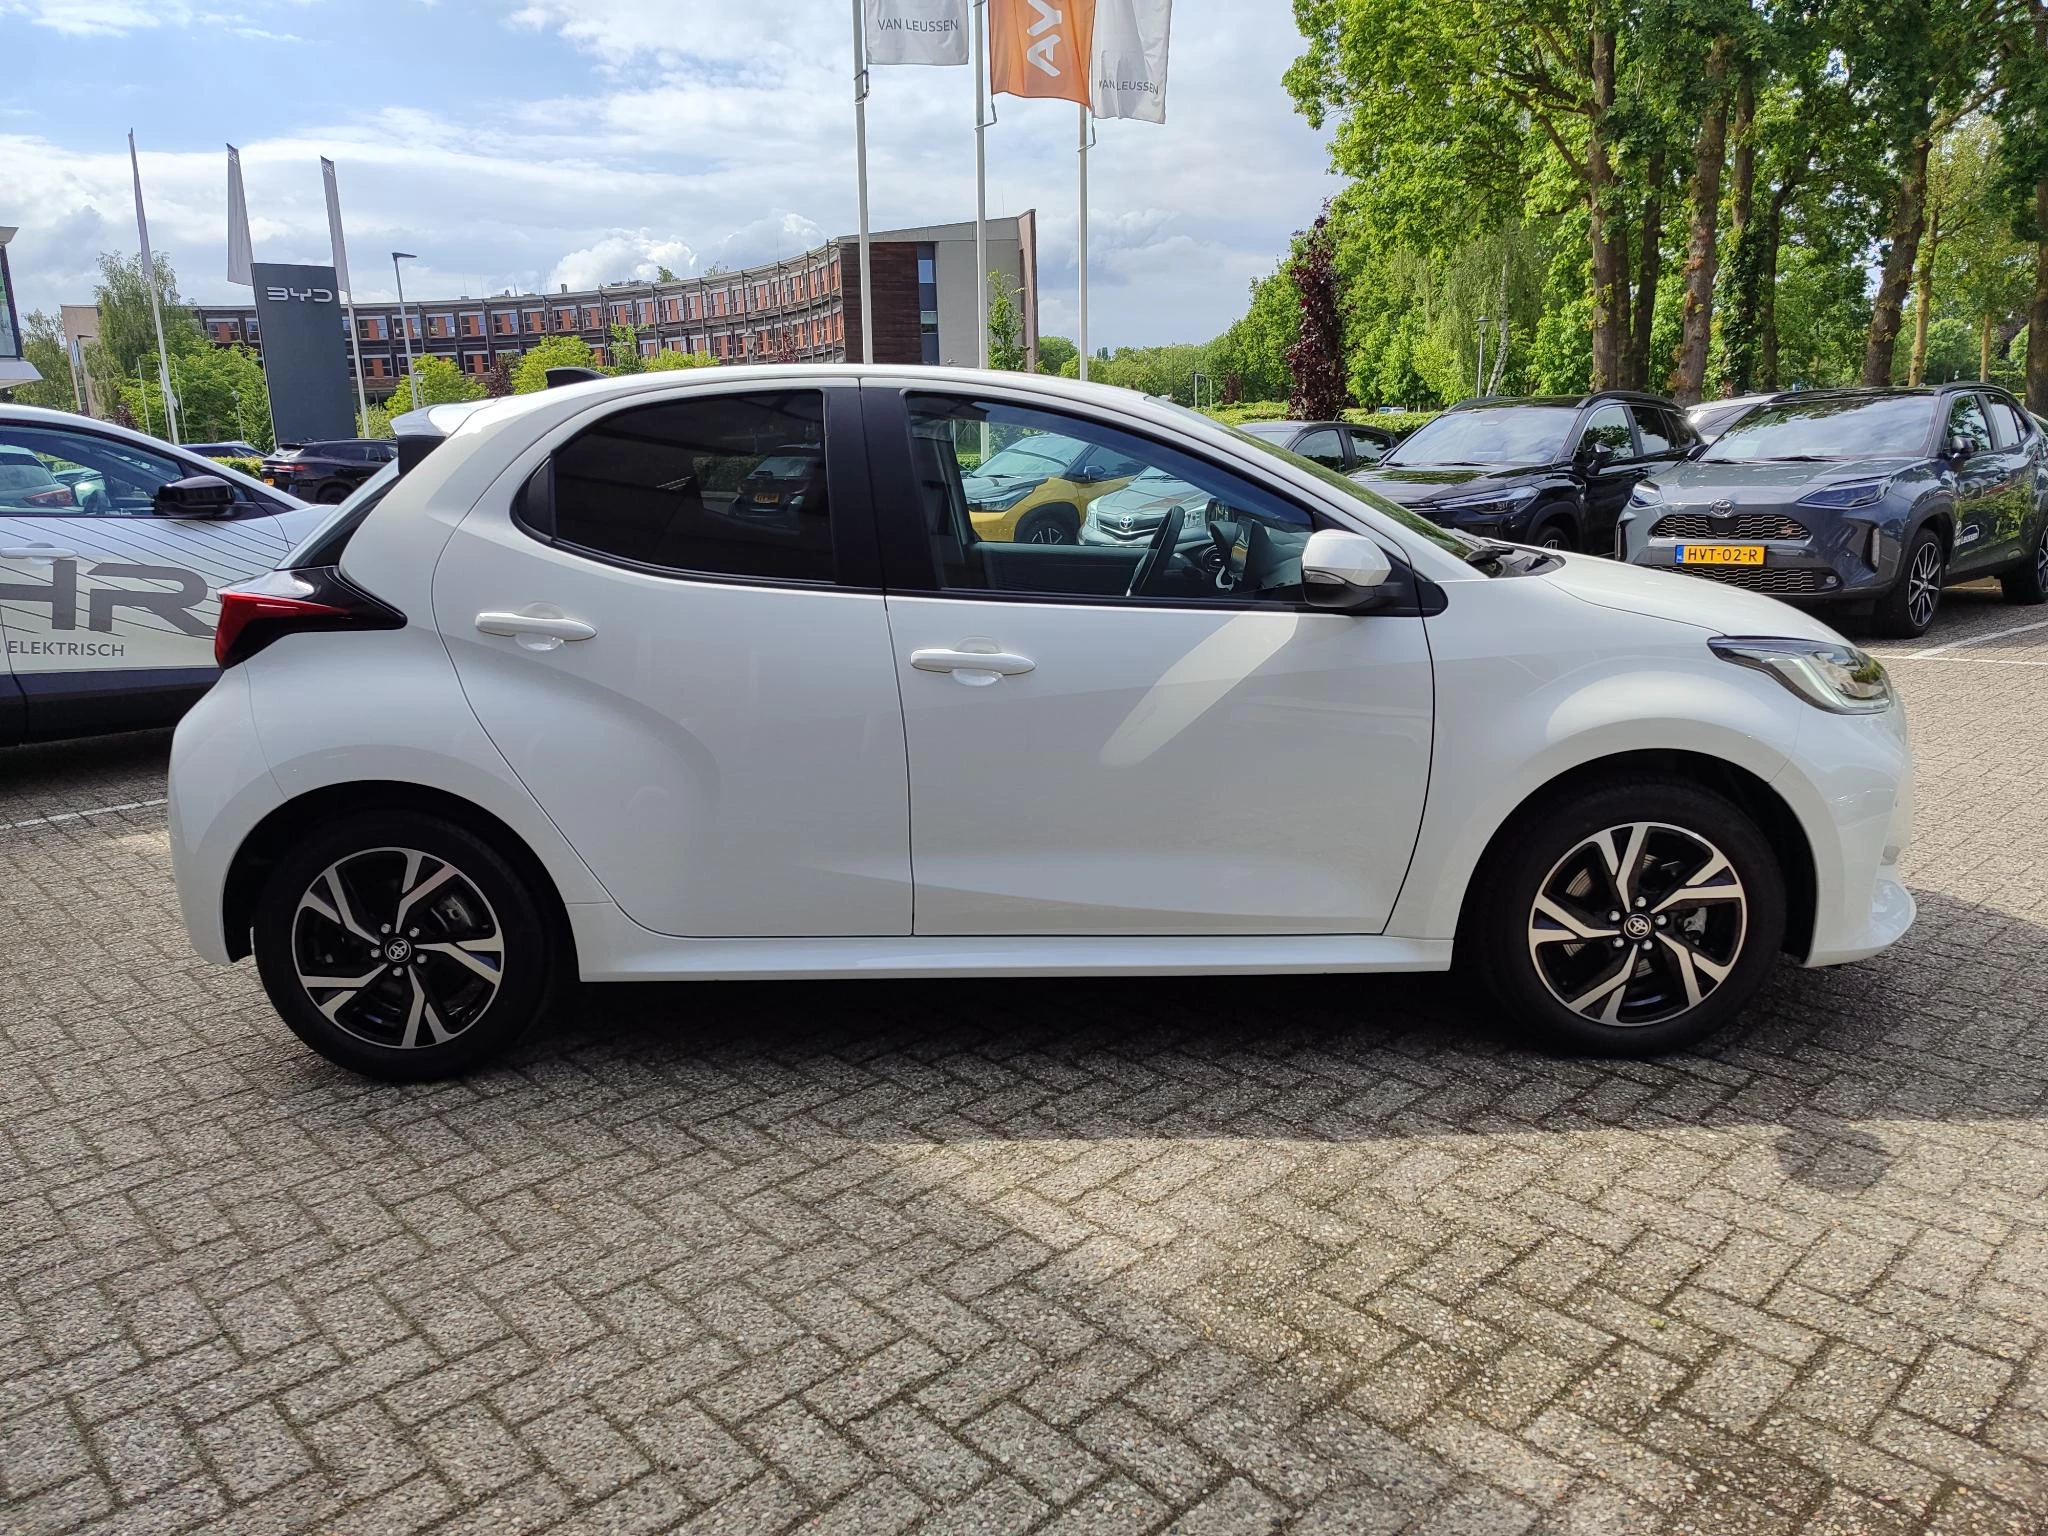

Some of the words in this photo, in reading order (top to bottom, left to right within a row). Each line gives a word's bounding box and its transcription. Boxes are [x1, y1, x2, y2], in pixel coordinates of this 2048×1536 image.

[877, 19, 902, 31] VAN
[905, 19, 959, 32] LEUSSEN
[1116, 81, 1159, 95] LEUSSEN
[266, 286, 333, 303] BYD
[1688, 547, 1758, 562] HVT-02-R
[7, 640, 125, 657] ELEKTRISCH
